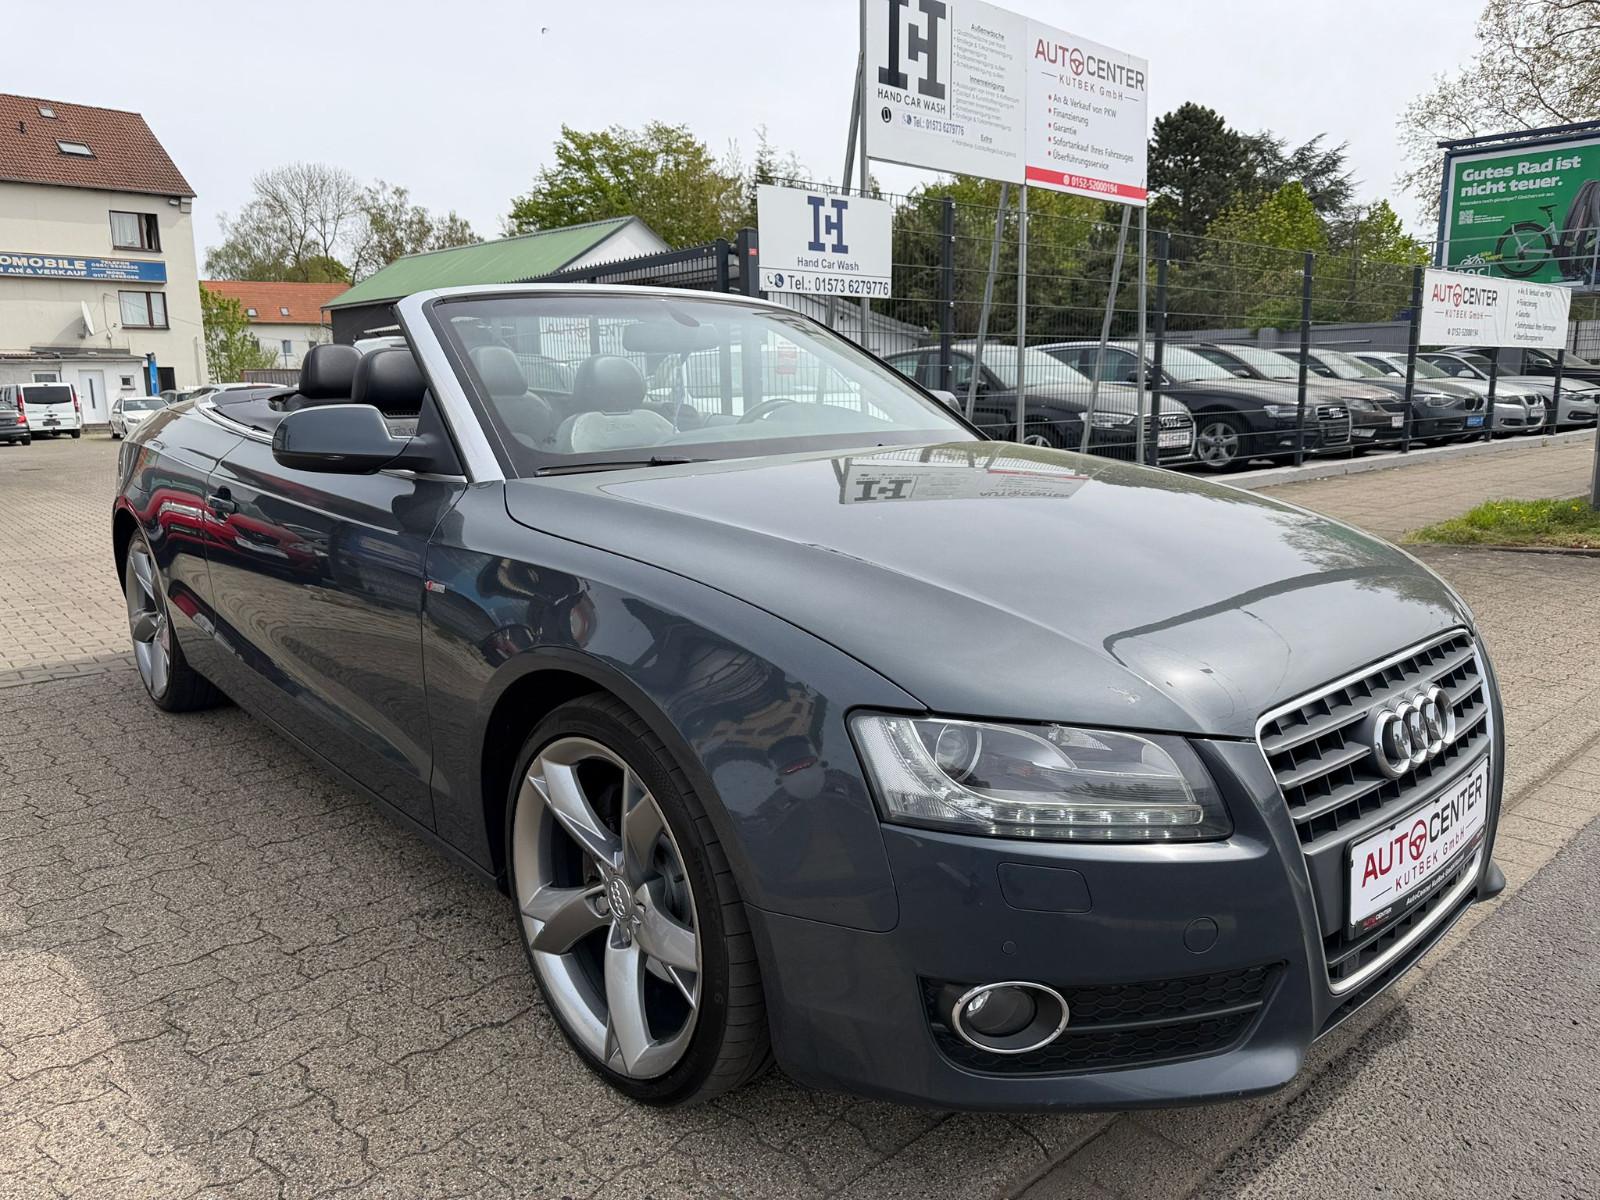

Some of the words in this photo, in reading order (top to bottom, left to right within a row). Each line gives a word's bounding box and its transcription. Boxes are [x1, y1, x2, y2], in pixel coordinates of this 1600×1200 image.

[1059, 73, 1095, 93] KUTBEK
[1099, 87, 1124, 101] GmbH
[877, 88, 902, 103] HAND
[904, 95, 921, 108] CAR
[923, 100, 946, 114] WASH
[1053, 94, 1062, 103] An
[1063, 96, 1069, 105] &
[1070, 98, 1091, 111] Verkauf
[1092, 105, 1102, 114] von
[1103, 107, 1117, 118] PKW
[1053, 108, 1088, 127] Finanzierung
[1053, 122, 1077, 135] Garantie
[1052, 136, 1089, 153] Sofortankauf
[1462, 166, 1514, 181] Gutes
[1516, 159, 1553, 176] Rad
[1555, 155, 1582, 170] ist
[1461, 181, 1506, 197] nicht
[1508, 176, 1563, 192] teuer.
[36, 268, 87, 276] VERKAUF
[797, 256, 819, 268] Hand
[821, 258, 835, 269] Car
[838, 261, 859, 271] Wash
[787, 275, 811, 291] Tel.:
[815, 277, 845, 293] 01573
[848, 280, 889, 296] 6279776
[1395, 849, 1438, 892] KUTBEK
[1442, 826, 1465, 856] GmbH
